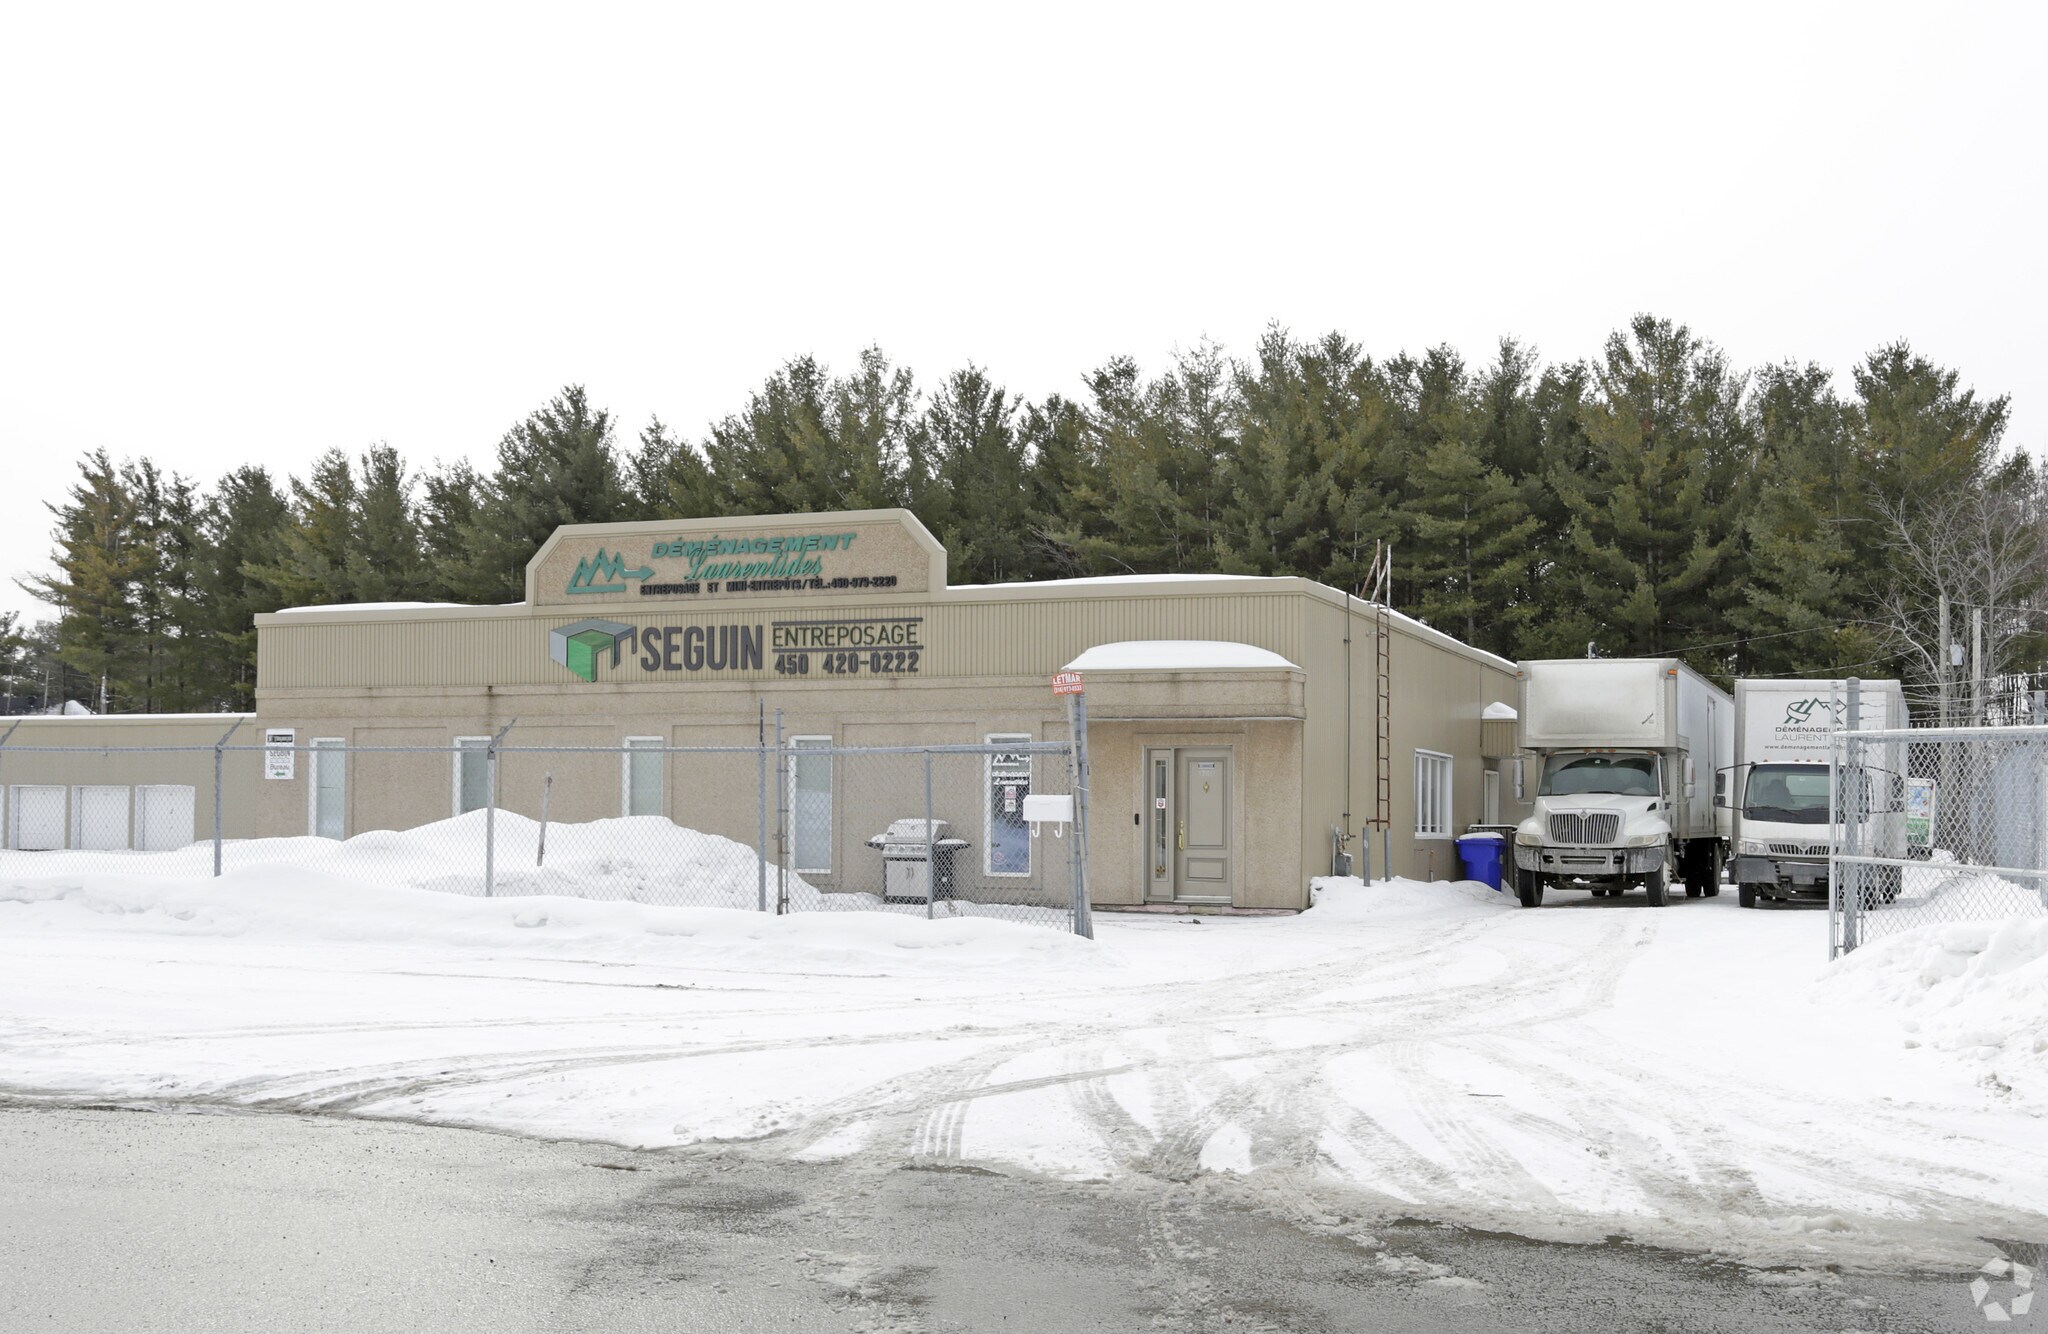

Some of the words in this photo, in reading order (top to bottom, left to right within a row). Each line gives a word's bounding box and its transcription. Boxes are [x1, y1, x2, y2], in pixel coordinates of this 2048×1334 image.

[651, 533, 857, 558] DÉMÉNAGEMENT
[684, 547, 822, 581] Laurentides
[640, 582, 700, 595] ENTREPOSAGE
[707, 582, 719, 593] ET
[772, 624, 918, 647] ENTREPOSAGE
[640, 625, 763, 671] SEGUIN
[774, 653, 809, 675] 450
[822, 651, 919, 674] 420-0222
[1052, 673, 1081, 685] LETMAR
